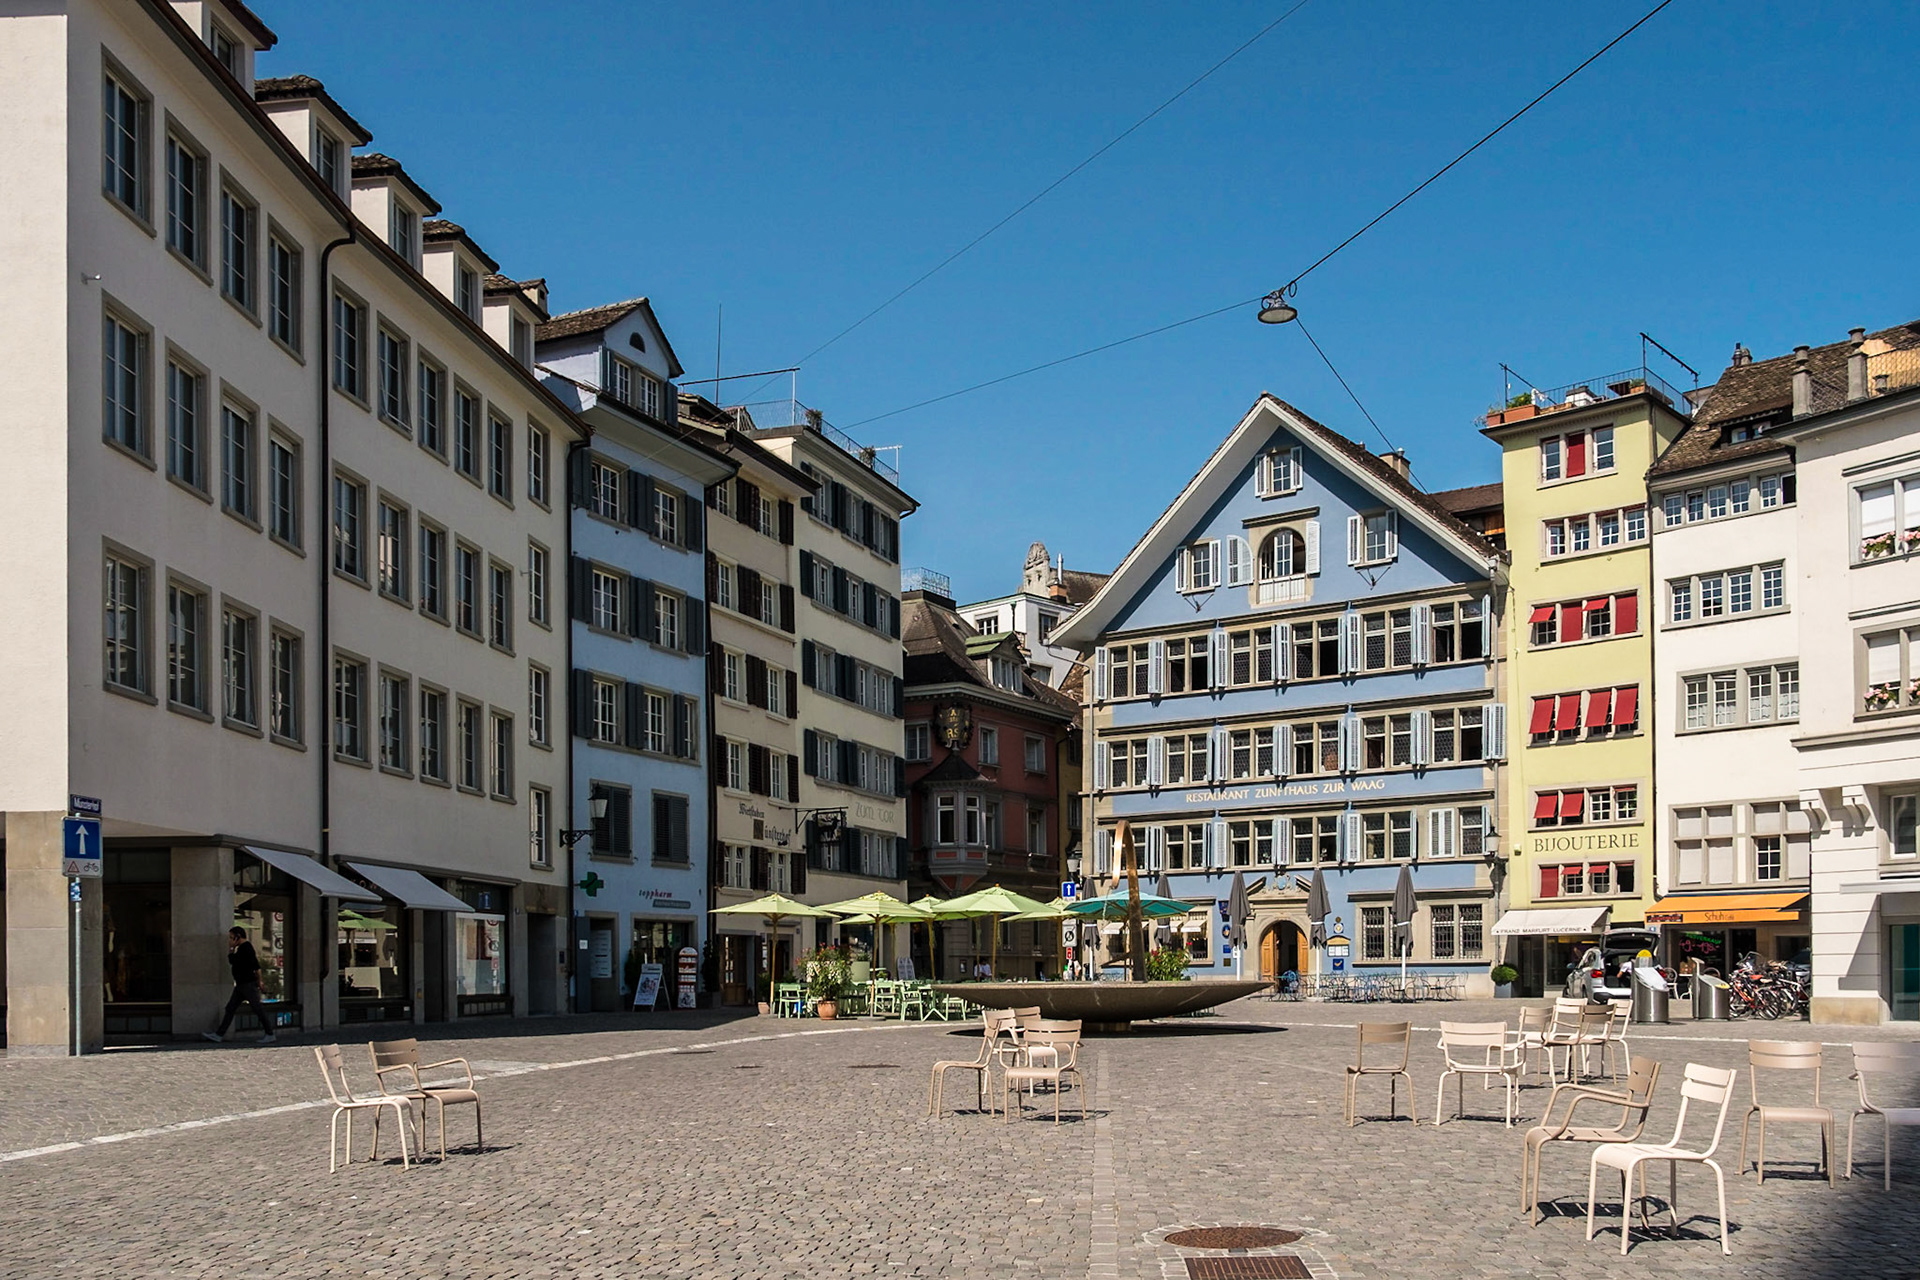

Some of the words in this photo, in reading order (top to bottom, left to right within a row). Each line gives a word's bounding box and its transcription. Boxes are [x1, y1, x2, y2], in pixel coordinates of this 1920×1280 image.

[1185, 789, 1250, 803] RESTAURANT
[1255, 785, 1318, 799] ZUNFTHAUS
[1322, 782, 1345, 794] ZUR
[1351, 778, 1385, 791] WAAG
[1534, 833, 1640, 852] BIJOUTERIE
[638, 889, 673, 900] toppharm
